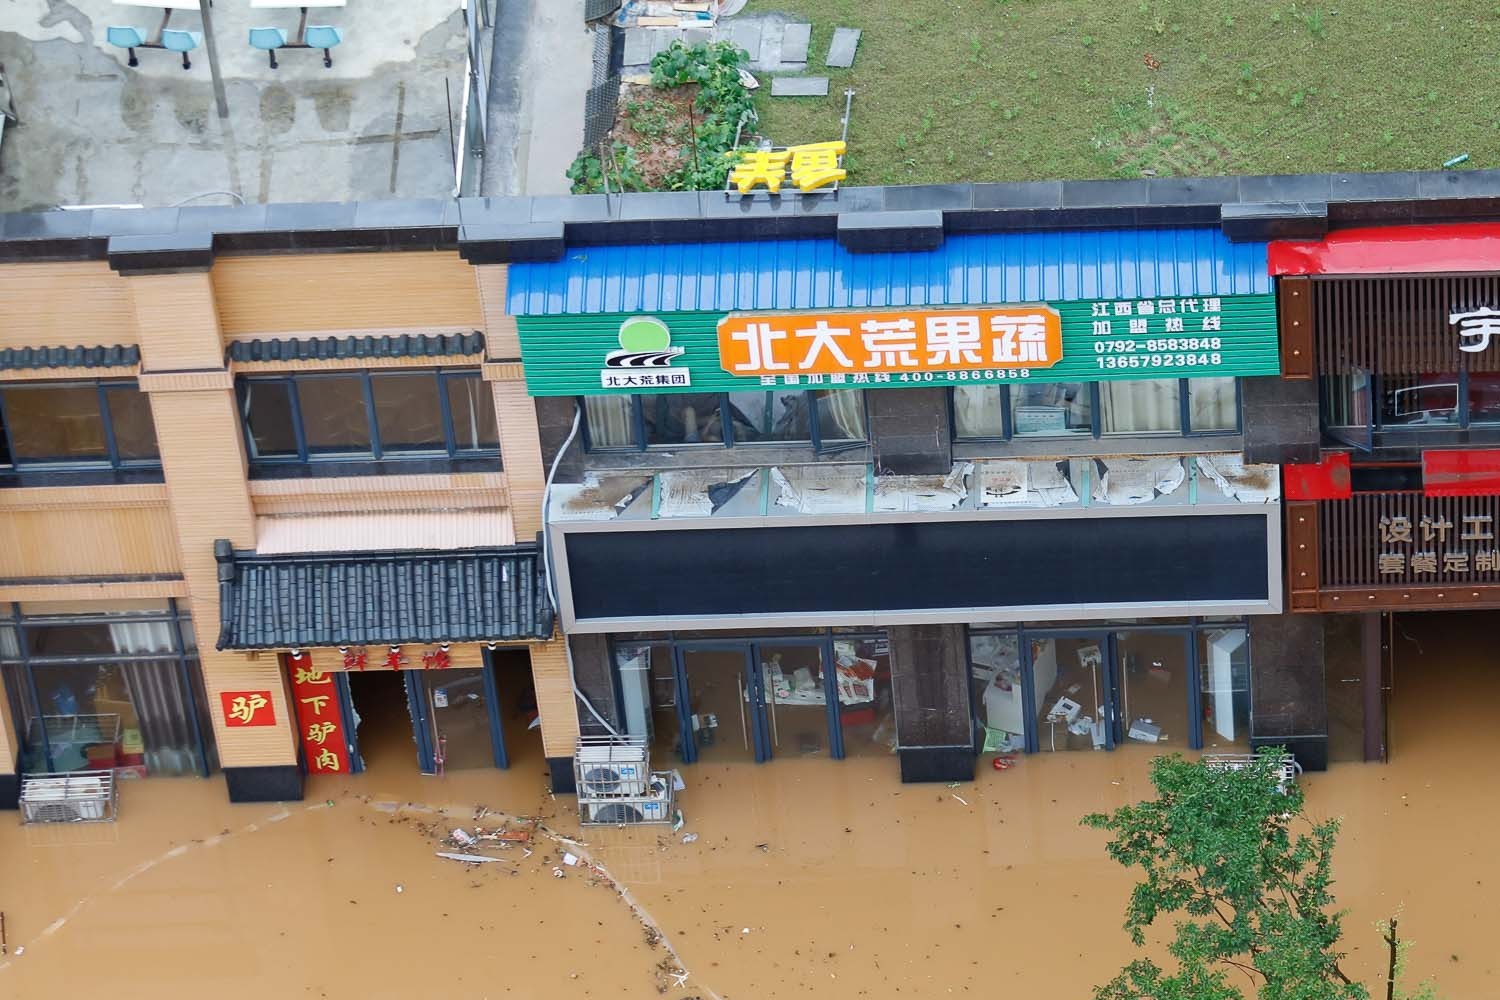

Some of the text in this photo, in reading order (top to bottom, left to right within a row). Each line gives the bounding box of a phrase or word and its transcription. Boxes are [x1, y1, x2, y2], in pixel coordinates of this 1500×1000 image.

[1091, 298, 1221, 317] 江西省总代理
[1093, 316, 1221, 335] 加盟热线
[731, 314, 1048, 371] 北大荒果蔬
[1094, 337, 1221, 353] 0792-8583848
[1096, 353, 1222, 369] 13657923848
[606, 374, 686, 387] 北大荒集团
[900, 368, 1031, 382] 400-8866858
[1378, 549, 1500, 575] 套餐定制
[229, 693, 268, 724] 驴
[296, 666, 340, 772] 地下驴肉
